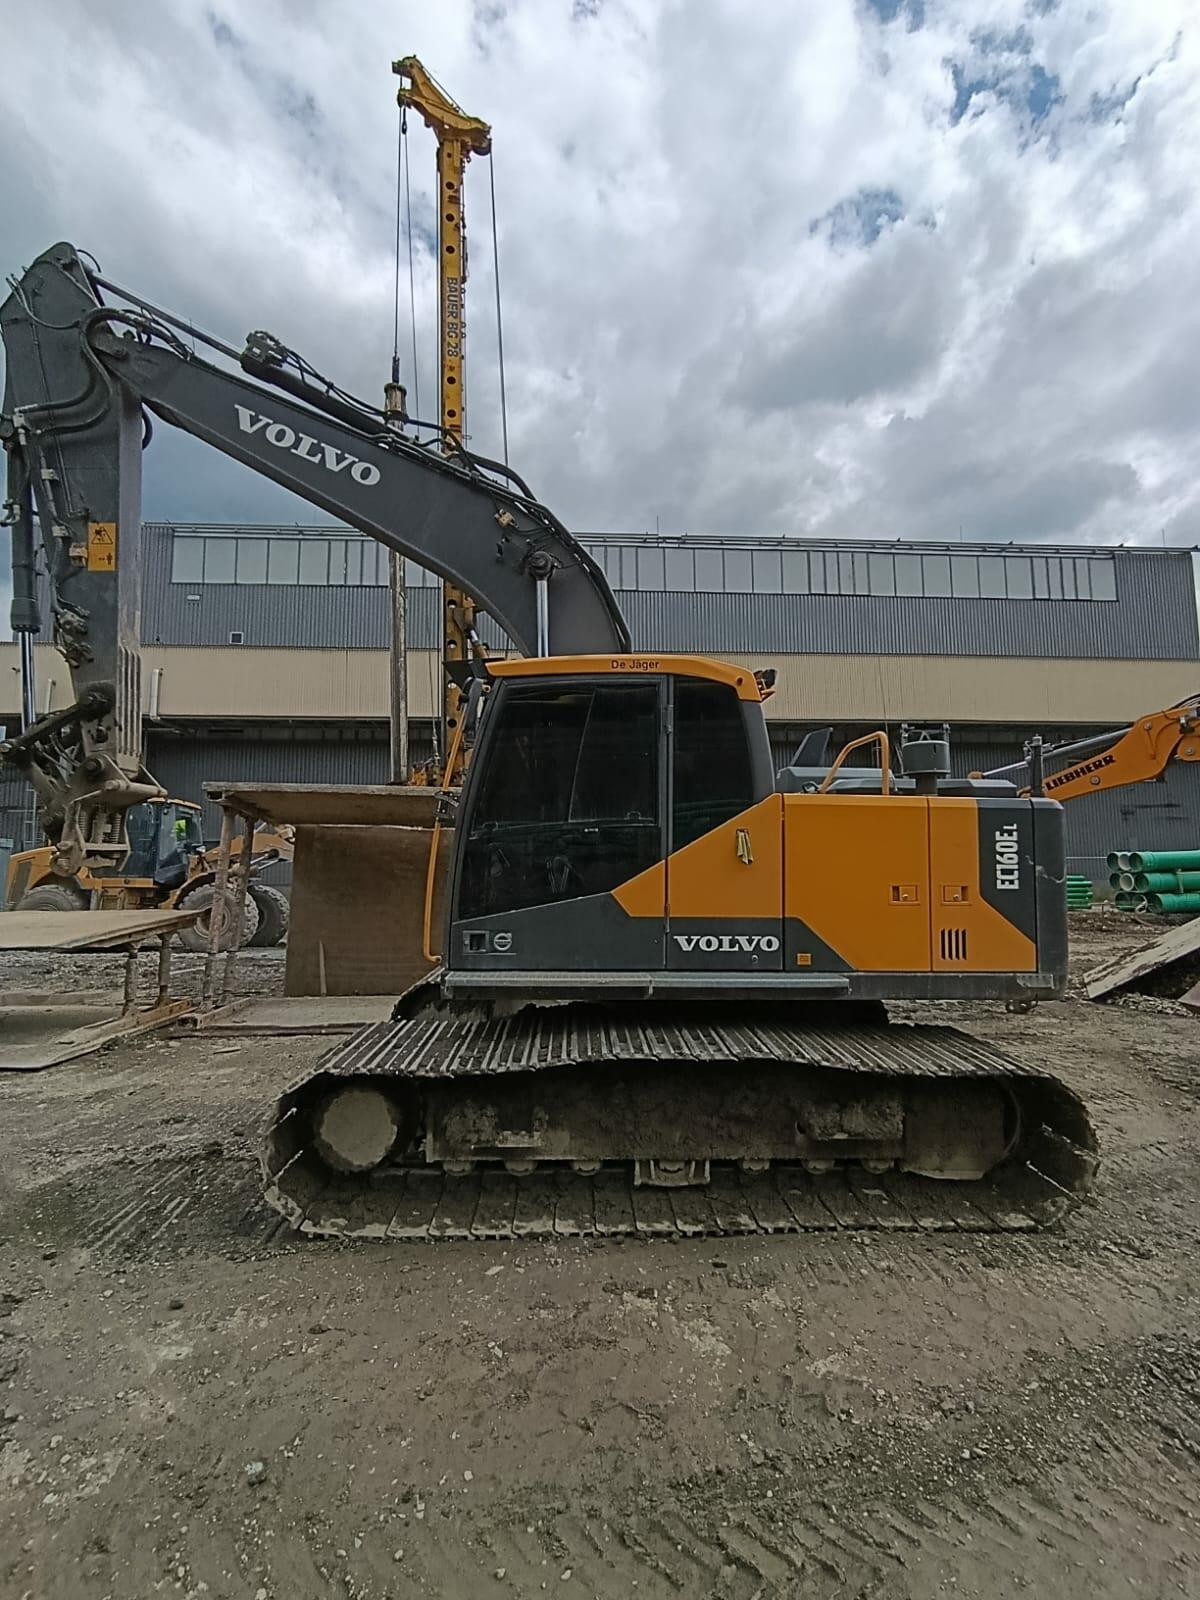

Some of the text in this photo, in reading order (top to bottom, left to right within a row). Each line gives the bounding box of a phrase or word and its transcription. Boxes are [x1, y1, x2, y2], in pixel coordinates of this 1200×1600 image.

[447, 277, 458, 357] BAUER BG 28
[234, 404, 381, 485] VOLVO
[611, 659, 660, 671] De Jäger
[1045, 755, 1116, 791] LIEBHERR
[673, 935, 780, 951] VOLVO
